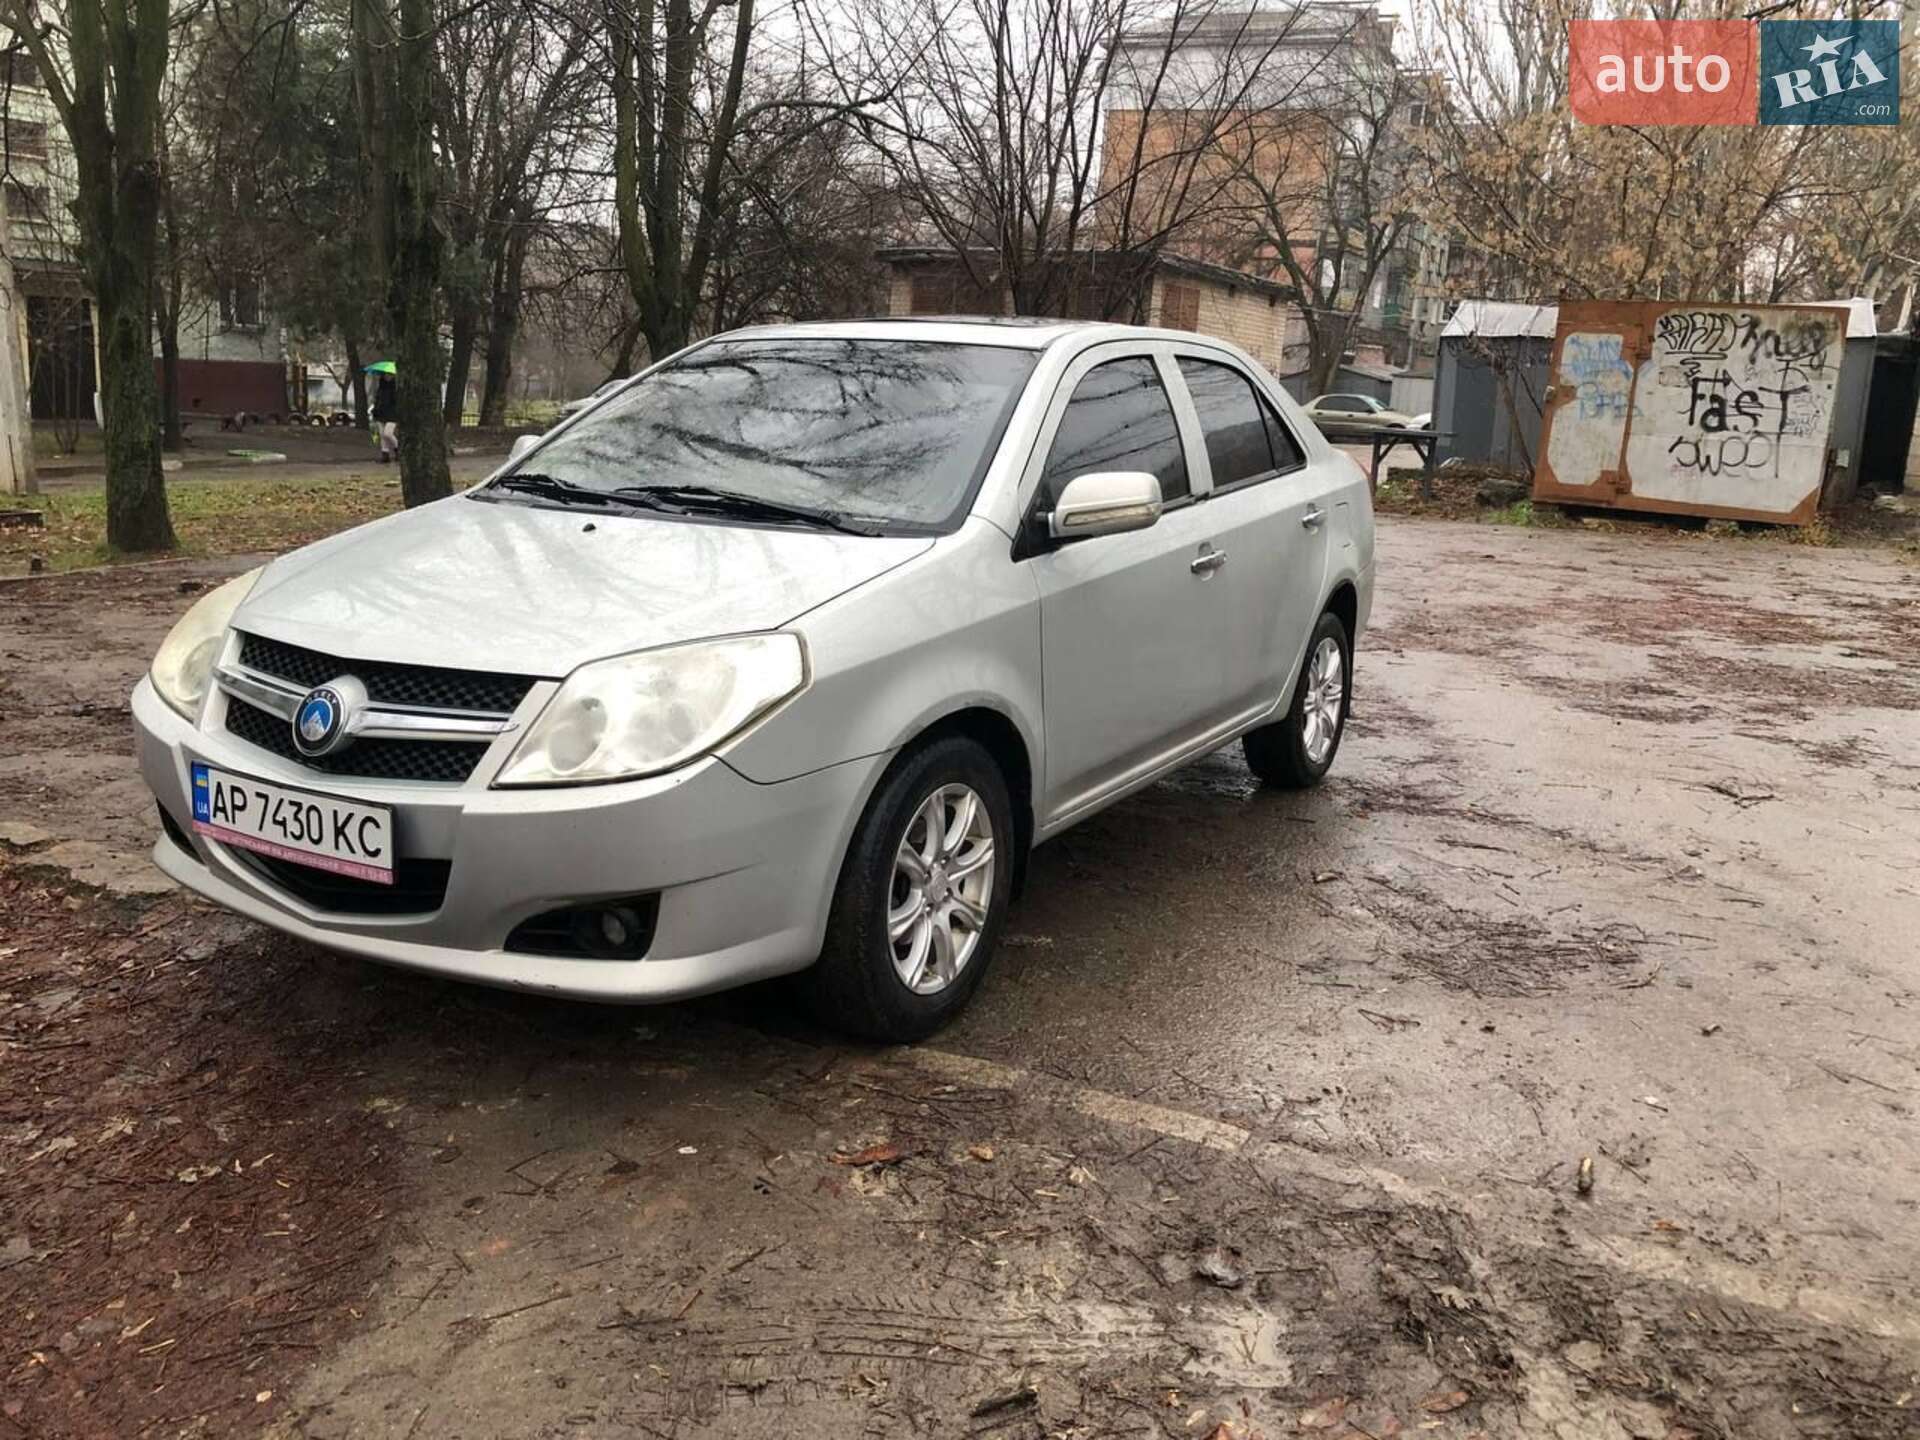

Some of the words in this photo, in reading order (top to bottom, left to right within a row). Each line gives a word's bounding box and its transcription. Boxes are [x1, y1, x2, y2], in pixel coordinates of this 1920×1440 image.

[196, 801, 209, 815] UA
[212, 781, 248, 825] AP
[254, 791, 324, 845] 7430
[332, 808, 382, 858] KC
